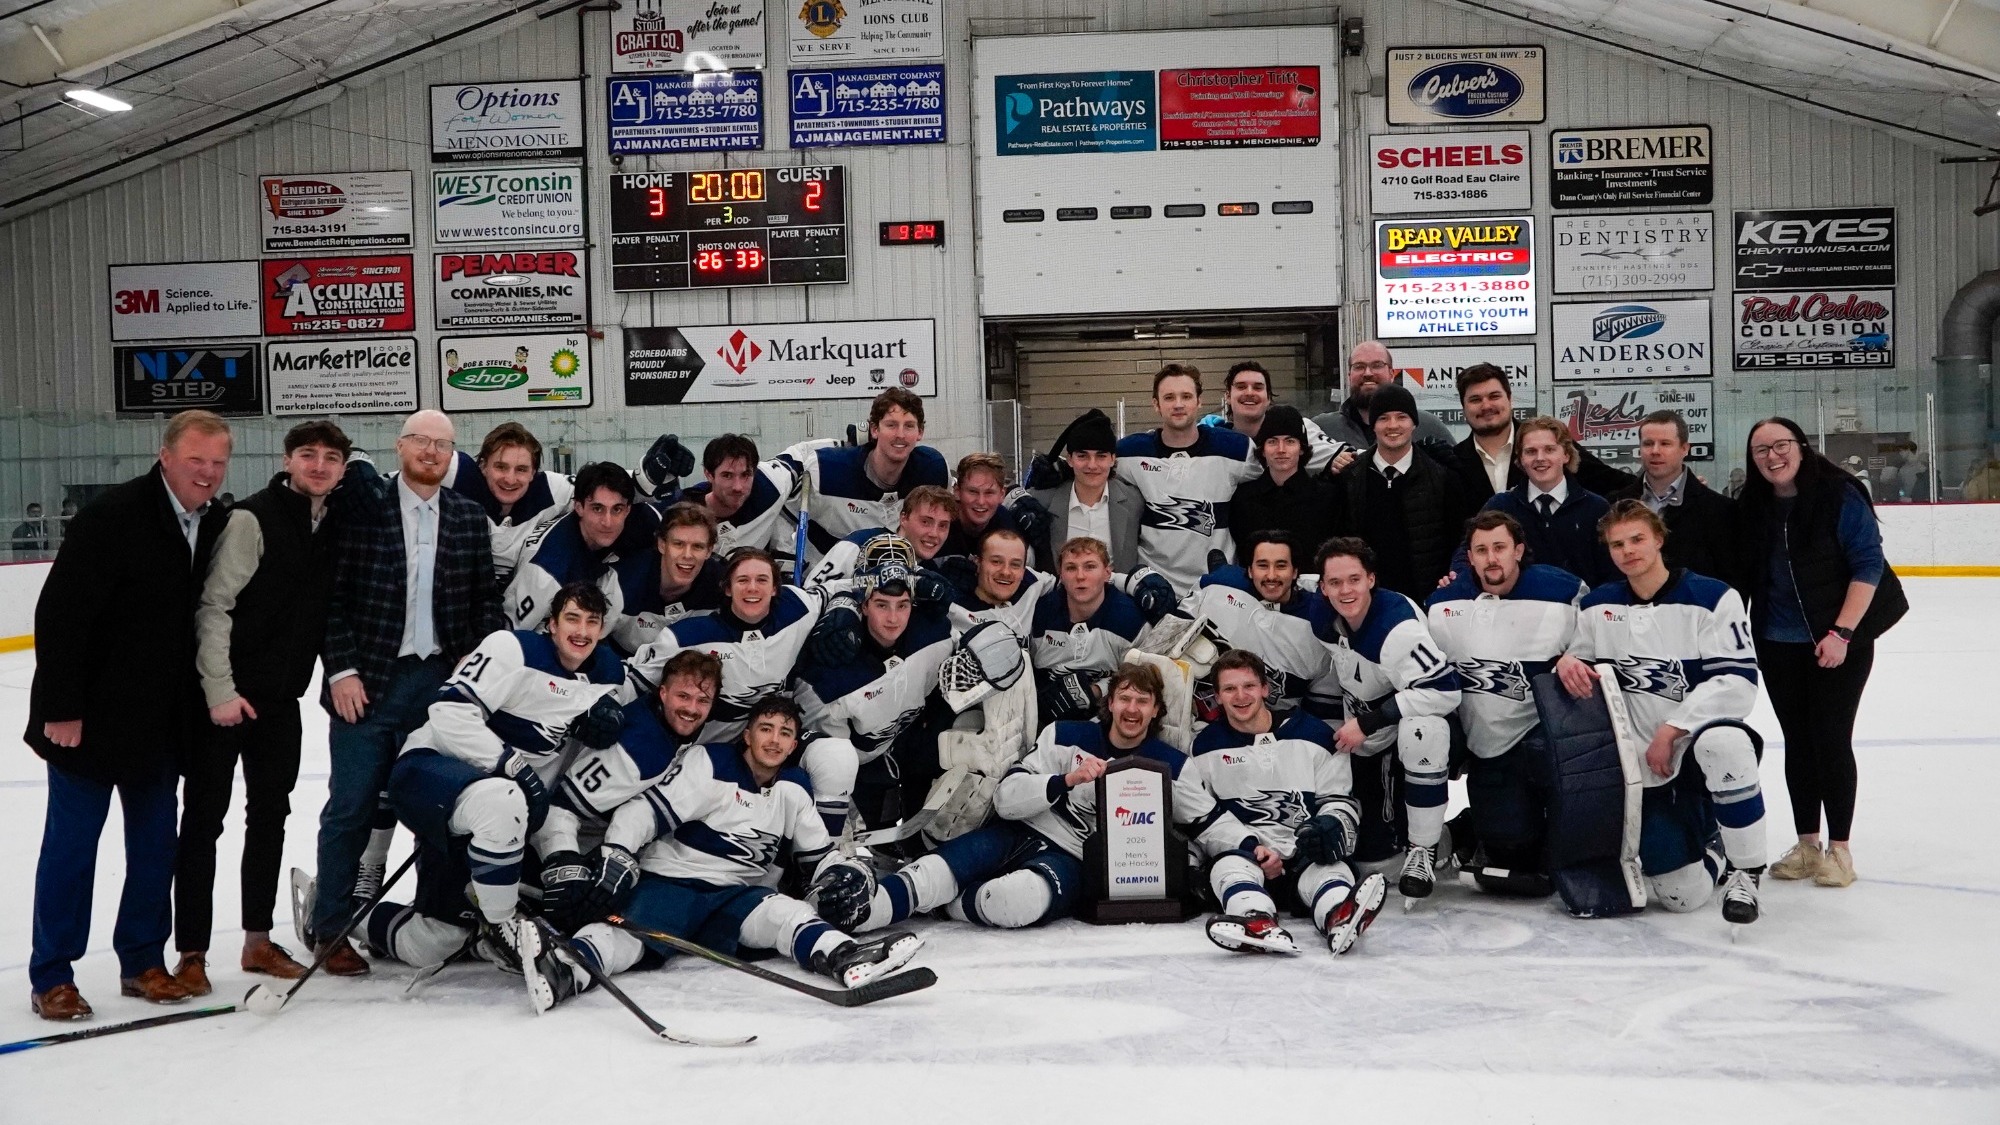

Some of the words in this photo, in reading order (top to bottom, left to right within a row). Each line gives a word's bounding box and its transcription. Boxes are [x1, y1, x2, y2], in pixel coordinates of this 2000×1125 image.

[706, 2, 728, 18] Join
[731, 5, 741, 14] us
[636, 20, 663, 31] STOUT
[687, 21, 710, 39] after
[713, 18, 727, 30] the
[729, 11, 762, 34] game!
[864, 14, 894, 24] LIONS
[902, 14, 928, 23] CLUB
[620, 33, 657, 51] CRAFT
[661, 32, 679, 49] CO.
[861, 32, 883, 42] Helping
[885, 31, 895, 39] The
[898, 30, 932, 39] Community
[797, 44, 813, 52] WE
[1395, 53, 1414, 61] JUST
[1425, 52, 1457, 60] BLOCKS
[717, 79, 758, 87] COMPANY
[838, 73, 897, 82] MANAGEMENT
[1177, 72, 1263, 89] Christopher
[1267, 71, 1298, 84] Tritt
[1039, 81, 1054, 89] First
[1055, 81, 1070, 89] Keys
[1421, 68, 1498, 105] Culver's
[456, 86, 560, 116] Options
[838, 97, 939, 112] 715-235-7780
[656, 105, 757, 120] 715-235-7780
[1039, 97, 1145, 121] Pathways
[490, 110, 563, 123] Women
[885, 118, 912, 126] STUDENT
[913, 117, 939, 125] RENTALS
[1042, 125, 1061, 133] REAL
[1063, 124, 1090, 132] ESTATE
[1100, 122, 1146, 131] PROPERTIES
[448, 133, 568, 149] MENOMONIE
[795, 129, 941, 143] AJMANAGEMENT.NET
[614, 136, 758, 150] AJMANAGEMENT.NET
[1586, 136, 1706, 161] BREMER
[452, 150, 562, 160] www.optionsmenomonie.com
[1378, 144, 1523, 168] SCHEELS
[776, 167, 833, 182] GUEST
[1382, 176, 1408, 185] 4710
[1411, 176, 1433, 184] Golf
[1436, 175, 1463, 183] Road
[1489, 174, 1520, 182] Claire
[1557, 172, 1593, 181] Banking
[1602, 170, 1642, 179] Insurance
[1651, 169, 1674, 177] Trust
[1676, 168, 1706, 176] Service
[438, 172, 572, 195] WESTconsin
[623, 174, 673, 189] HOME
[692, 172, 762, 201] 20:00
[1606, 179, 1657, 188] Investments
[272, 184, 333, 196] BENEDICT
[806, 182, 821, 209] 2
[1414, 190, 1487, 200] 715-833-1886
[498, 194, 535, 205] CREDIT
[537, 193, 572, 203] UNION
[650, 188, 664, 216] 3
[502, 210, 514, 218] We
[517, 209, 544, 219] belong
[547, 209, 555, 217] to
[273, 224, 346, 234] 715-834-3191
[1568, 220, 1606, 228] RED
[1628, 217, 1700, 227] CEDAR
[440, 224, 580, 238] www.westconsincu.org
[771, 230, 799, 238] PLAYER
[806, 228, 839, 236] PENALTY
[1388, 228, 1442, 250] BEAR
[1445, 225, 1520, 249] VALLEY
[1559, 229, 1708, 246] DENTISTRY
[1738, 218, 1892, 245] KEYES
[270, 237, 405, 248] www.BenedictRefrigeration.com
[646, 235, 680, 243] PENALTY
[738, 241, 759, 249] GOAL
[1738, 244, 1890, 255] CHEVYTOWNUSA.COM
[1396, 252, 1514, 264] ELECTRIC
[441, 252, 581, 282] PEMBER
[1385, 280, 1530, 293] 715-231-3880
[1582, 275, 1618, 289] (715)
[1622, 273, 1686, 286] 309-2999
[165, 289, 213, 299] Science.
[451, 286, 545, 299] COMPANIES,
[547, 286, 572, 296] INC
[115, 290, 160, 314] 3M
[284, 282, 404, 317] ACCURATE
[318, 299, 405, 309] CONSTRUCTION
[1390, 296, 1525, 305] bv-electric.com
[166, 302, 210, 315] Applied
[213, 301, 224, 311] to
[1388, 309, 1473, 320] PROMOTING
[1479, 308, 1528, 317] YOUTH
[1741, 295, 1800, 324] Red
[1801, 293, 1889, 322] Cedar
[292, 322, 311, 330] 715
[312, 318, 384, 330] 235-0827
[452, 315, 572, 324] PEMBERCOMPANIES.com
[1419, 322, 1498, 332] ATHLETICS
[1741, 322, 1885, 337] COLLISION
[567, 338, 578, 347] bp
[629, 349, 687, 358] SCOREBOARDS
[768, 336, 907, 367] Markquart
[1560, 343, 1704, 363] ANDERSON
[133, 350, 250, 380] NXT
[273, 347, 411, 371] MarketPlace
[630, 361, 665, 369] PROUDLY
[1739, 352, 1889, 366] 715-505-1691
[630, 371, 678, 380] SPONSORED
[1575, 366, 1690, 374] BRIDGES
[458, 370, 521, 388] shop
[826, 374, 855, 386] Jeep
[152, 382, 216, 397] STEP
[1660, 393, 1695, 403] DINE-IN
[276, 400, 412, 411] marketplacefoodsonline.com
[1688, 408, 1708, 418] OUT
[1443, 608, 1464, 617] WIAC
[1604, 610, 1626, 622] WIAC
[1410, 643, 1440, 673] 11
[459, 652, 491, 683] 21
[1354, 662, 1362, 683] A
[1223, 754, 1245, 765] WIAC
[575, 756, 611, 793] 15
[1116, 807, 1155, 826] WIAC
[1116, 876, 1158, 884] CHAMPION
